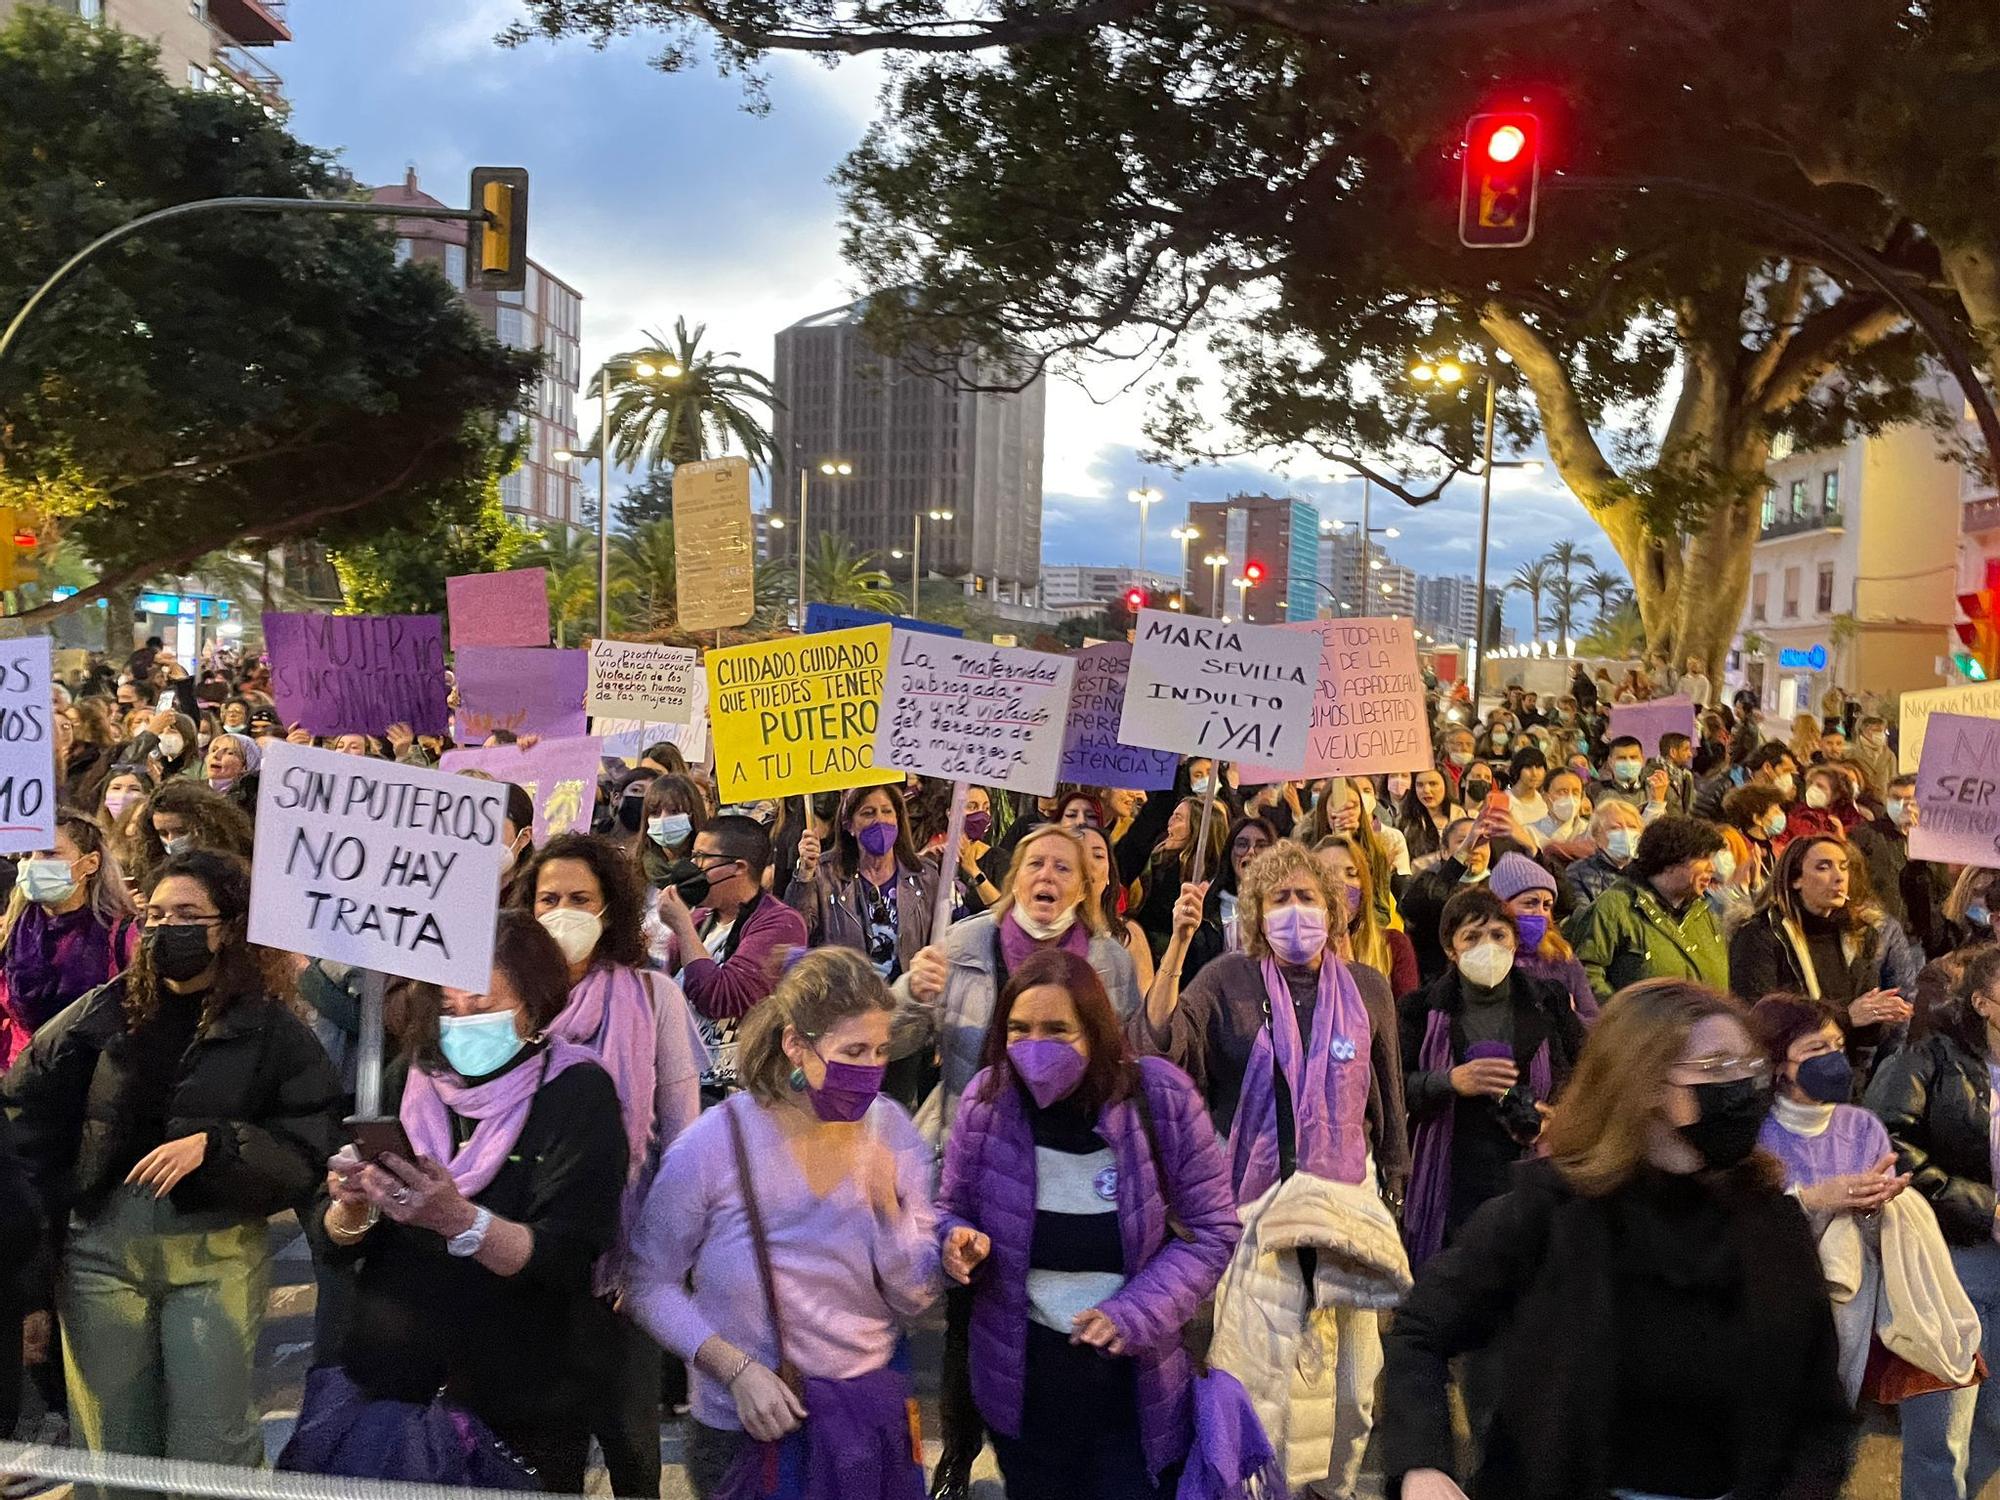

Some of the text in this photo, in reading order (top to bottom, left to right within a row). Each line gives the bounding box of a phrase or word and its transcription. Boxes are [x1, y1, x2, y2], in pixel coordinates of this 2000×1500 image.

[303, 614, 404, 671] MUJER
[594, 641, 613, 658] La
[901, 636, 934, 669] La
[1336, 627, 1381, 647] TODA
[1383, 627, 1400, 644] LA
[599, 658, 653, 670] violencia
[800, 641, 879, 673] CUIDADO
[1200, 658, 1307, 685] SEVILLA
[1340, 652, 1360, 670] DE
[1367, 651, 1390, 669] LA
[596, 680, 687, 694] derechos humanos
[650, 671, 662, 681] de
[668, 671, 682, 682] los
[719, 669, 883, 714] QUE PUEDES TENER
[595, 691, 684, 709] de las mujeres
[896, 698, 1050, 724] es una violación
[1147, 683, 1283, 710] INDULTO
[1351, 699, 1416, 725] LIBERTAD
[0, 704, 43, 742] OS
[760, 699, 879, 745] PUTERO
[892, 711, 1033, 741] del derecho de
[1197, 711, 1282, 757] ¡YA!
[890, 728, 1029, 765] las mujeres a
[1314, 728, 1418, 760] VENGANZA
[732, 744, 874, 784] A TU LADO
[941, 755, 1013, 779] salud
[1928, 775, 1996, 806] SER
[274, 767, 500, 846] SIN PUTEROS
[285, 827, 458, 900] NO HAY
[305, 890, 451, 960] TRATA
